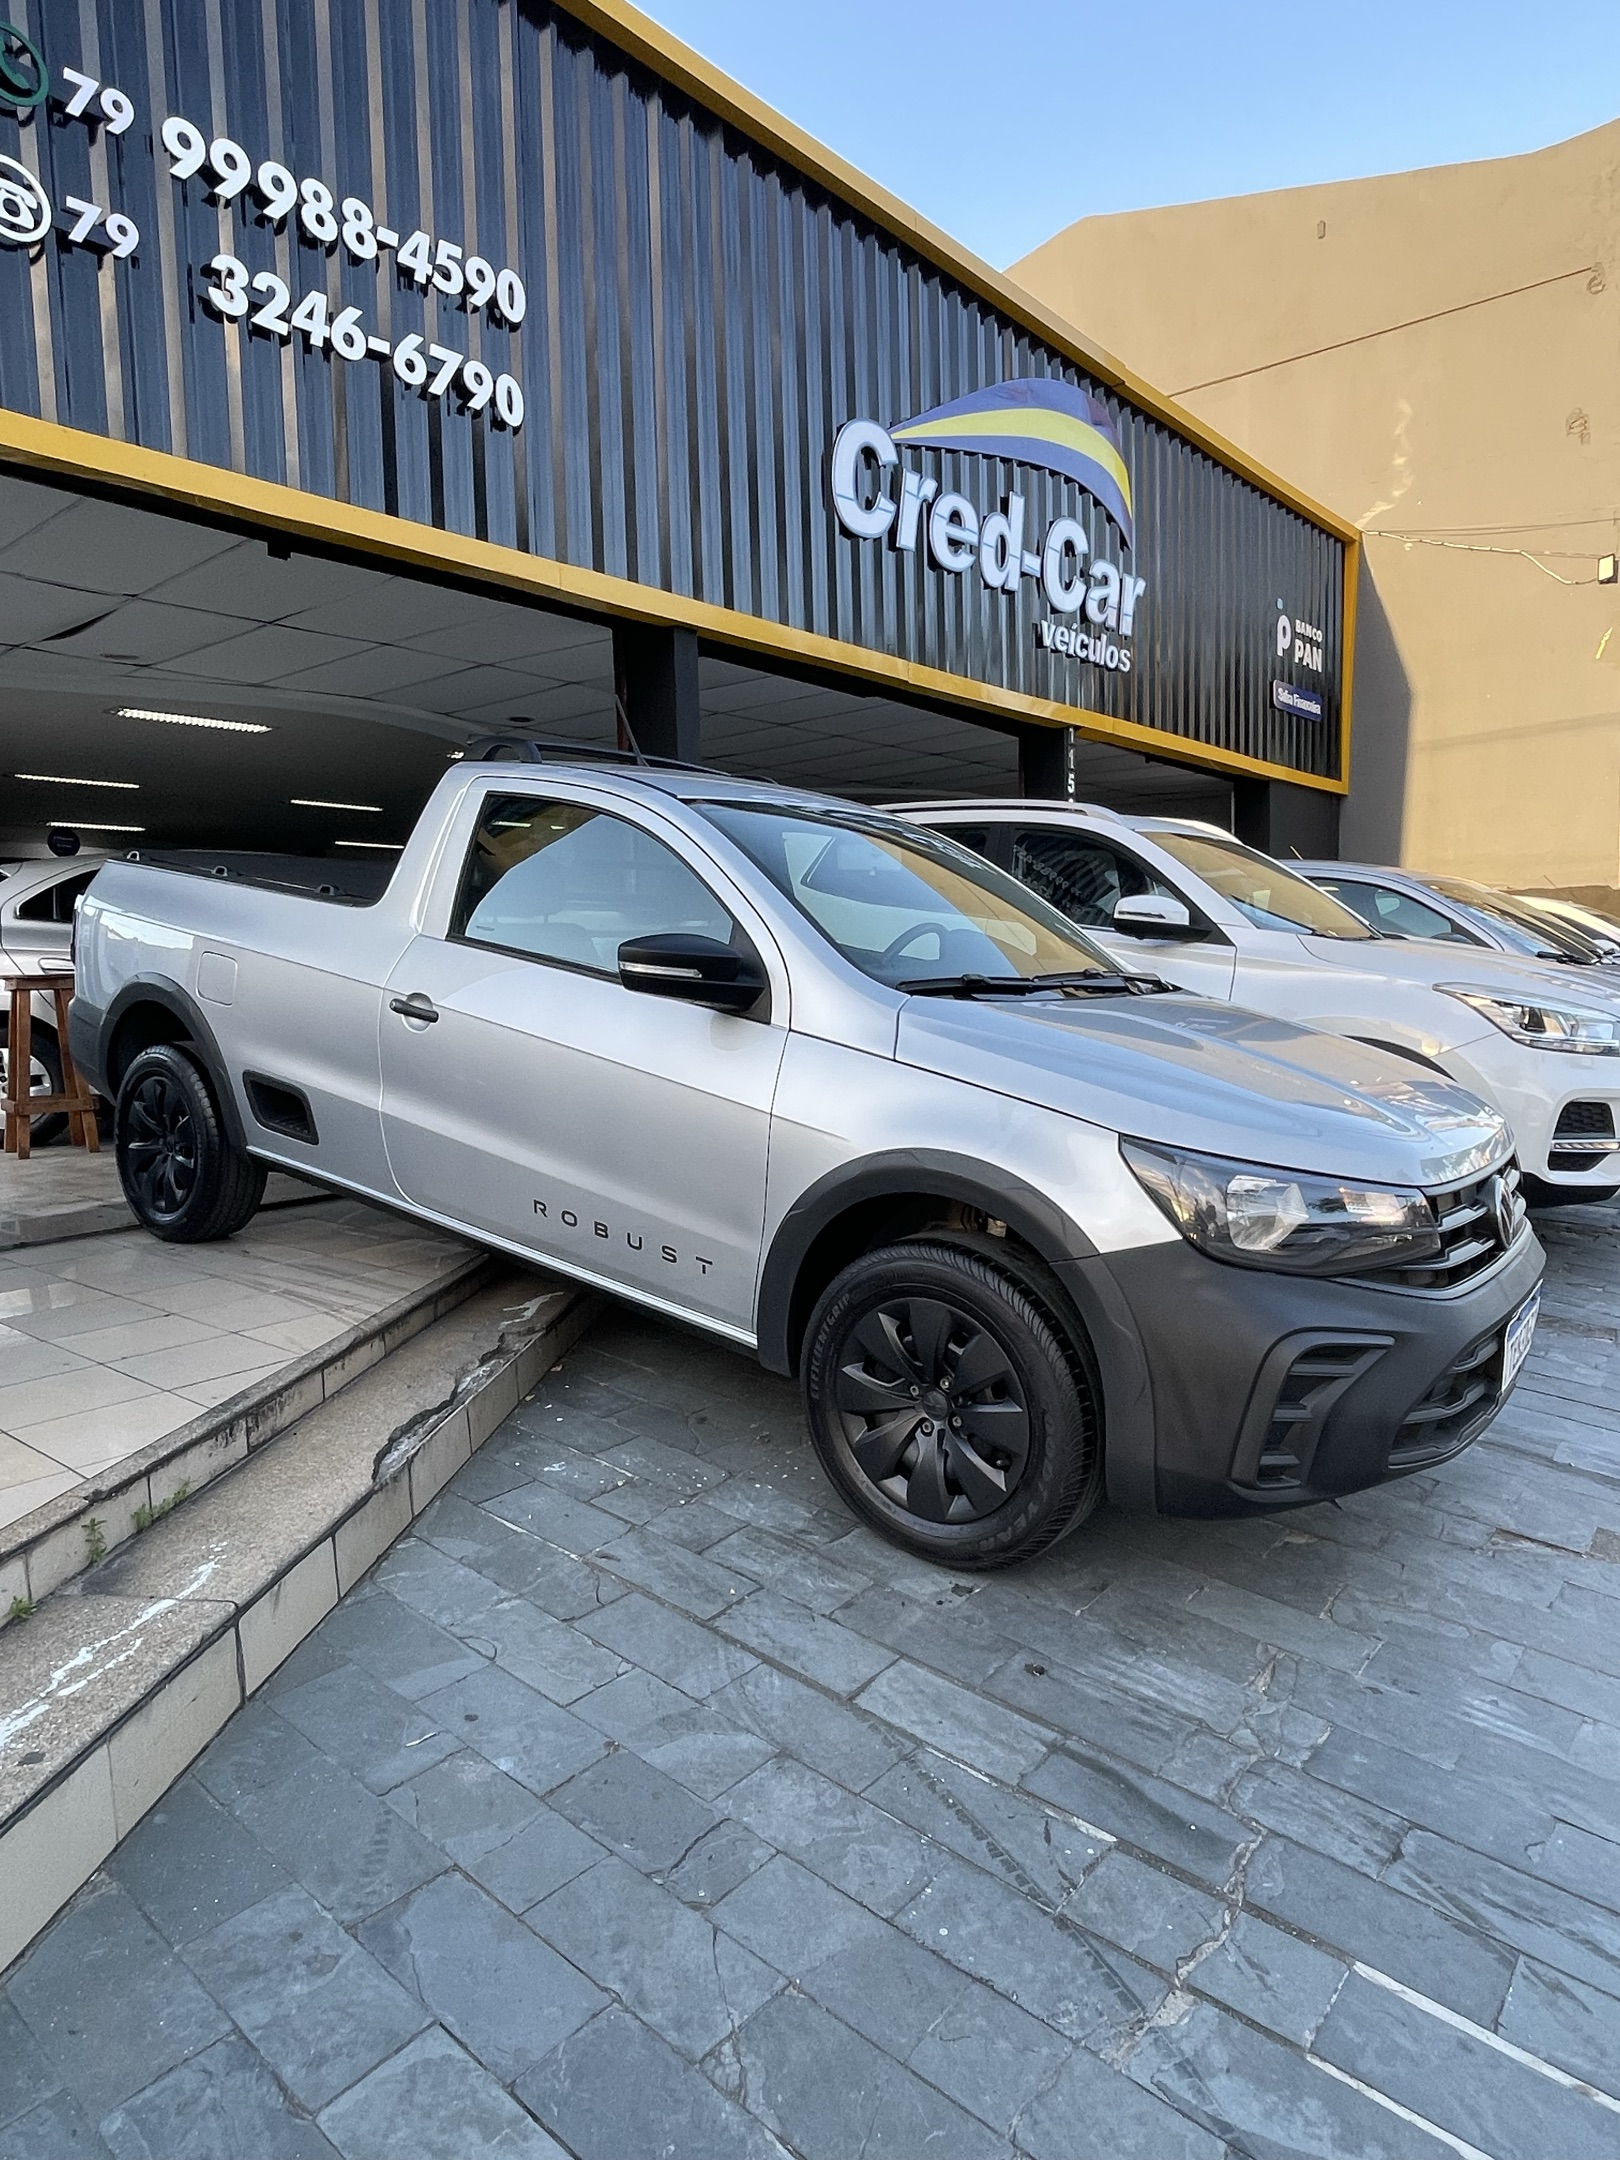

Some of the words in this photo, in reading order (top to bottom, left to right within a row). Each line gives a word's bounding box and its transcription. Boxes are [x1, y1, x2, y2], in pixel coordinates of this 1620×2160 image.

[63, 66, 135, 135] 79
[161, 116, 526, 324] 99988-4590
[65, 195, 140, 258] 79
[207, 253, 524, 427] 3246-6790
[832, 417, 1147, 637] Cred-Car
[1040, 618, 1132, 674] veículos
[1294, 618, 1323, 643] BANCO
[1294, 638, 1323, 673] PAN
[533, 1199, 713, 1275] ROBUST
